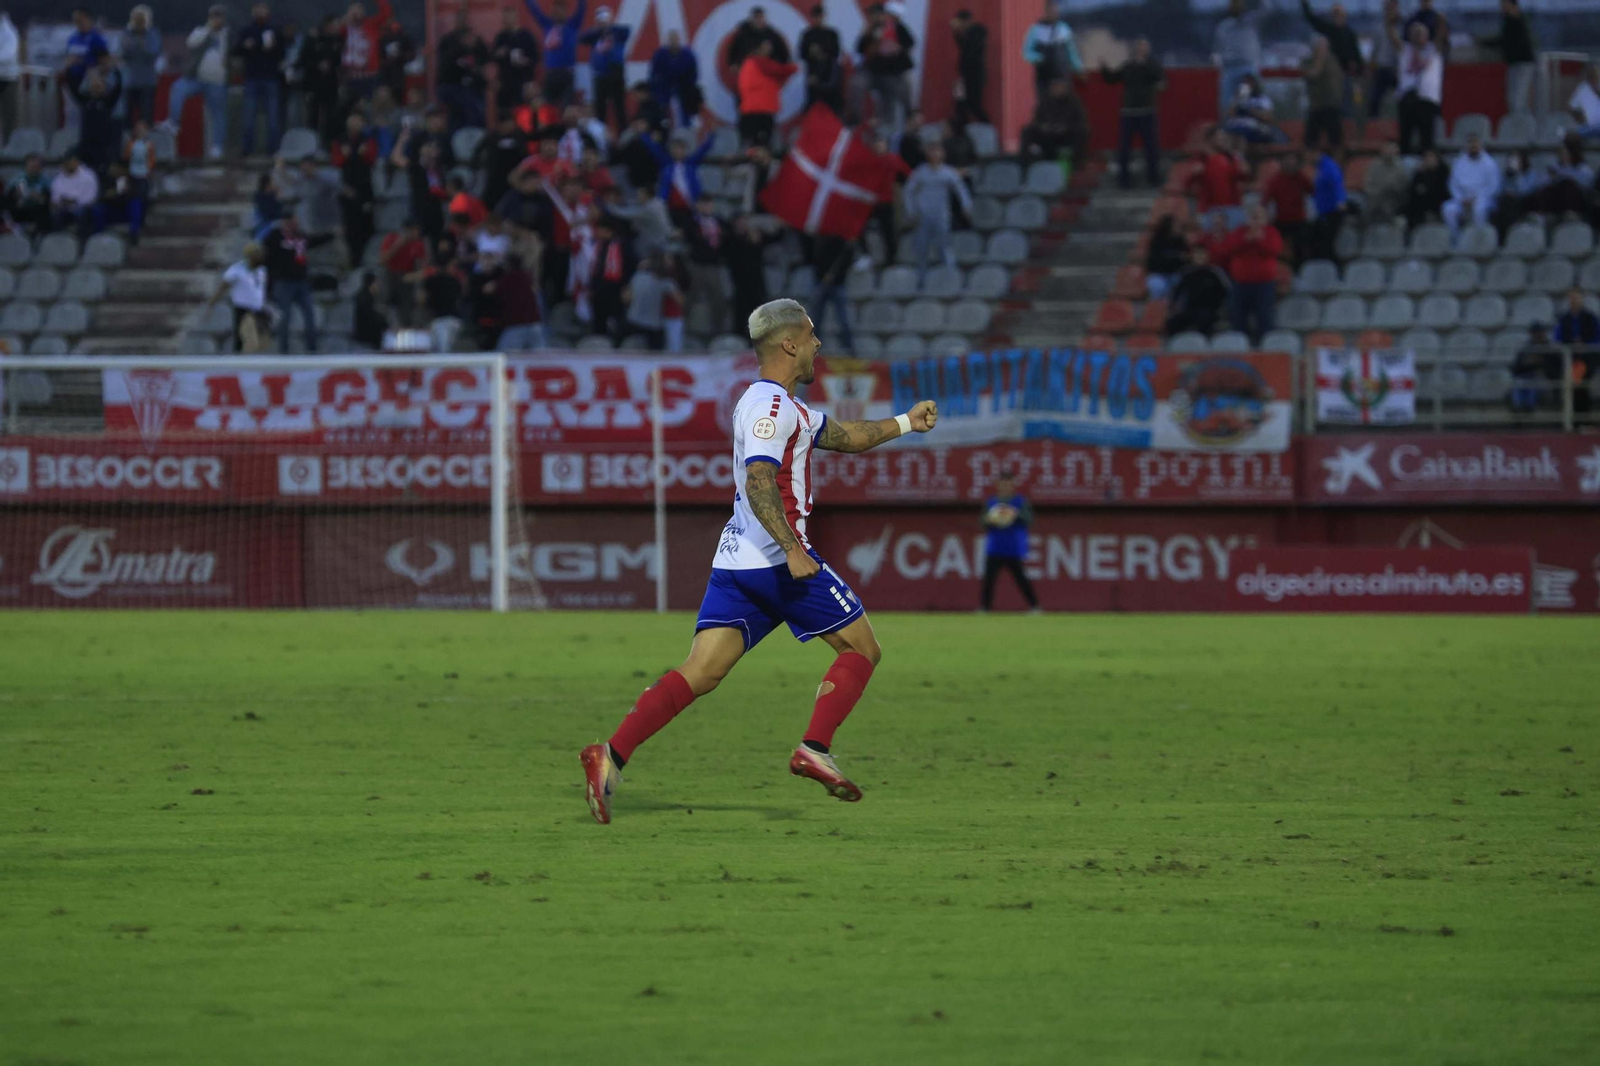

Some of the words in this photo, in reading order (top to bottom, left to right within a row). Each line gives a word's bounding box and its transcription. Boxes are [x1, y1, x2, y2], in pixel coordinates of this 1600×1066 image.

[36, 455, 223, 489] BESOCCER
[327, 454, 497, 488] BESOCCE
[1389, 444, 1560, 481] CaixaBank
